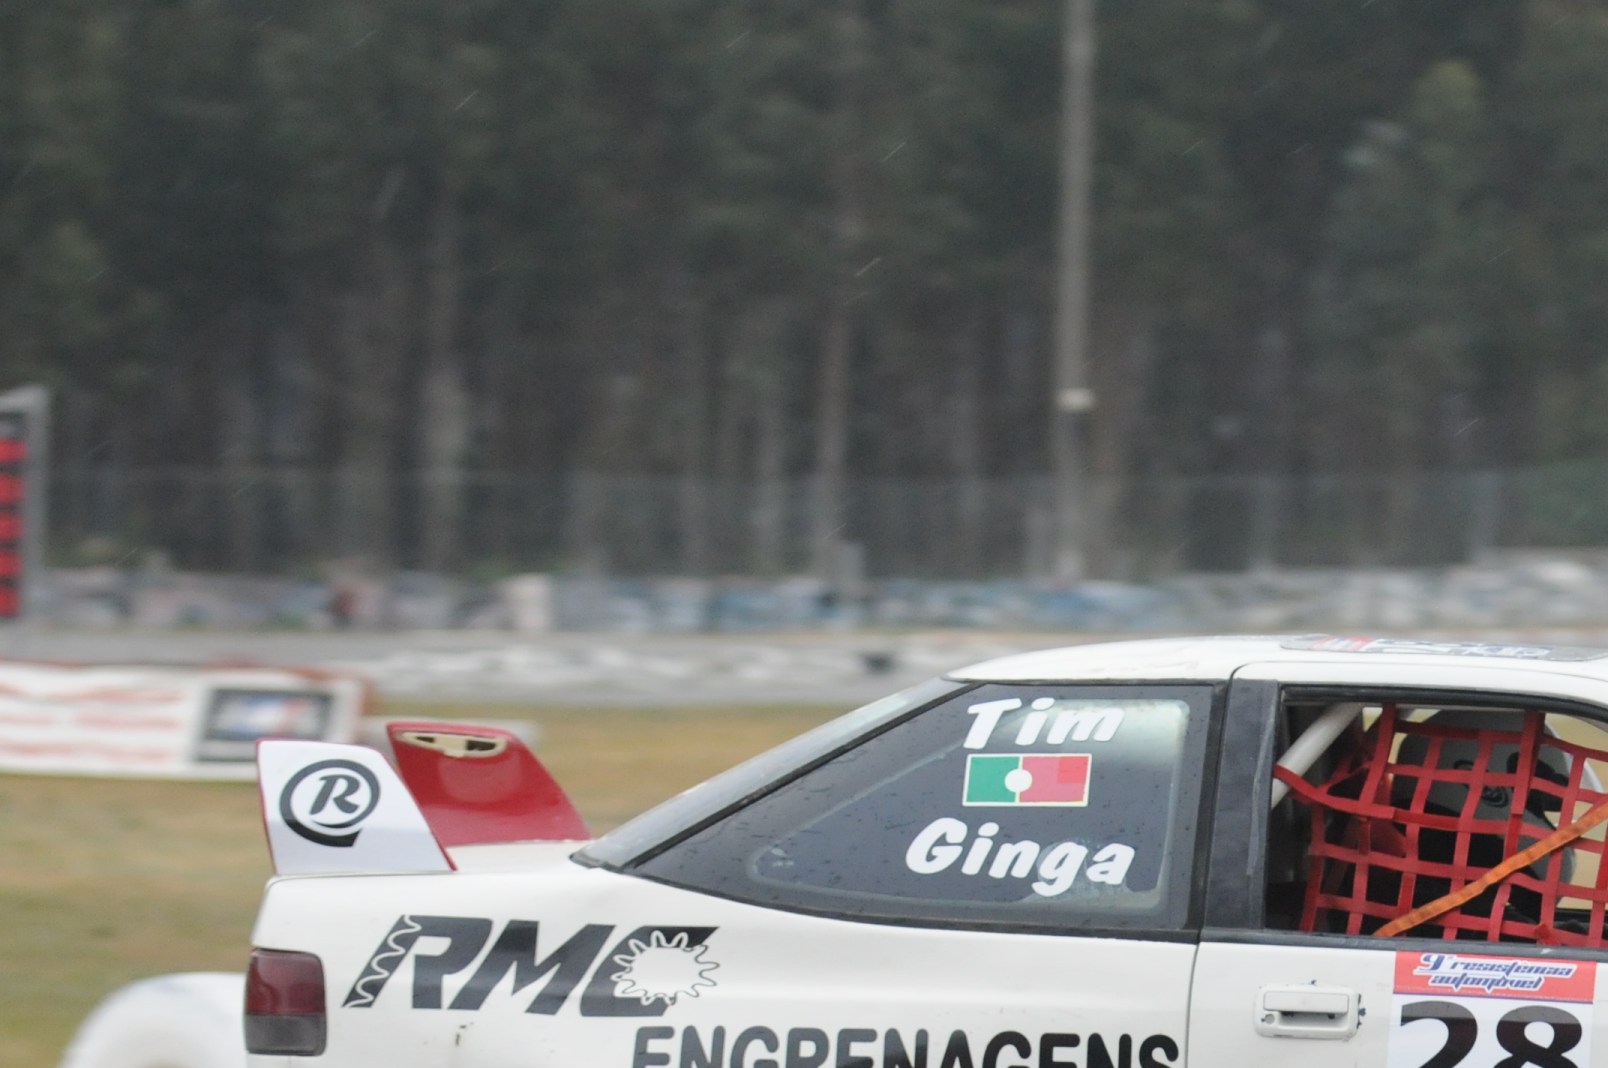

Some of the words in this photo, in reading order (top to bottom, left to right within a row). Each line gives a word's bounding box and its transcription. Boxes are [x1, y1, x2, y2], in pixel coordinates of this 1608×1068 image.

[963, 698, 1124, 749] Tim
[906, 817, 1135, 897] Ginga
[342, 914, 720, 1017] RMC
